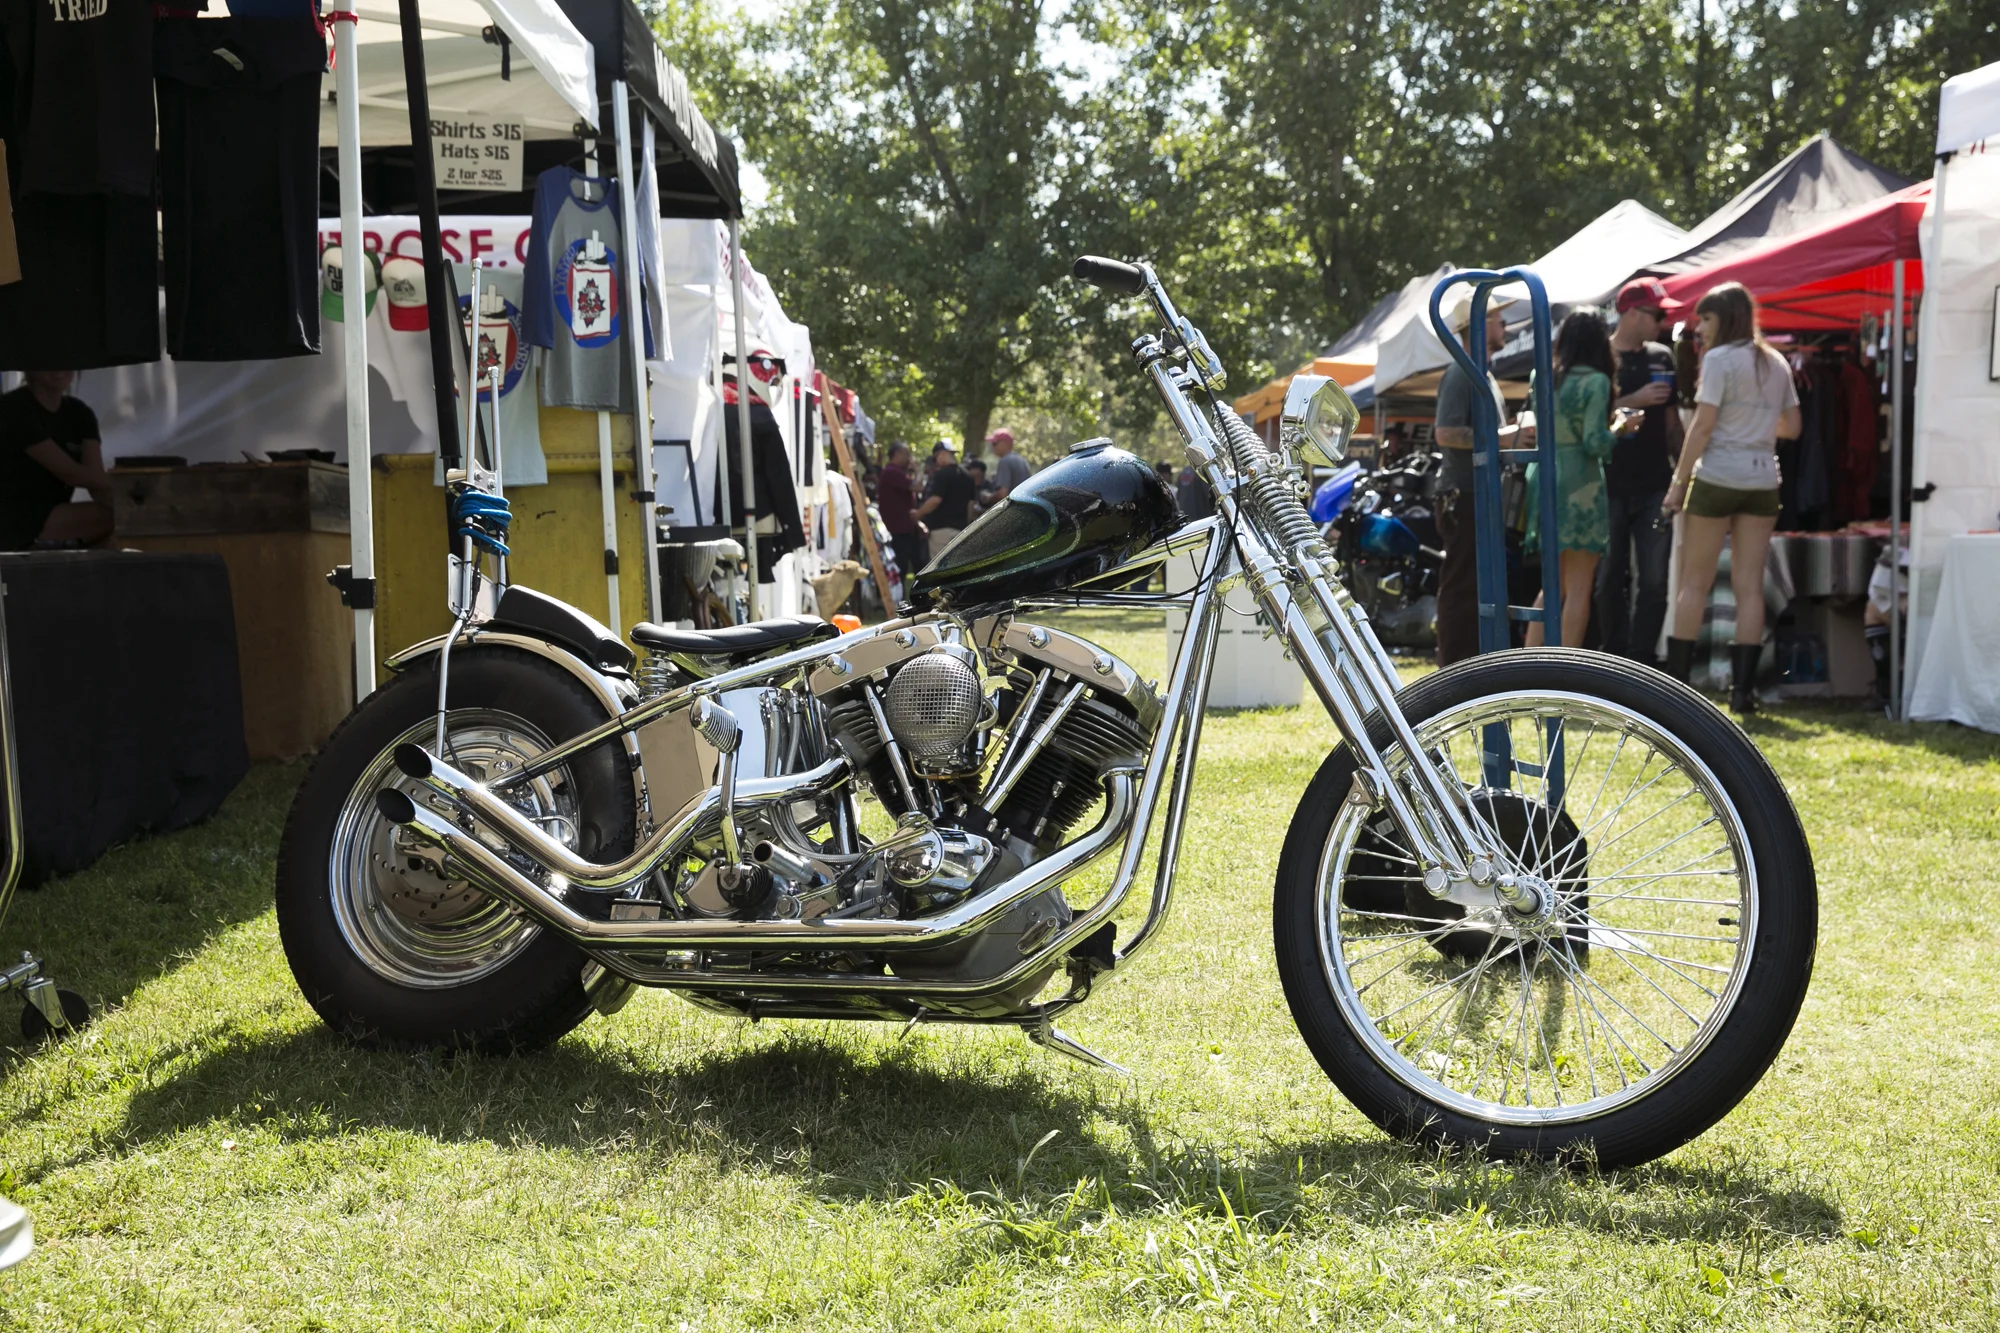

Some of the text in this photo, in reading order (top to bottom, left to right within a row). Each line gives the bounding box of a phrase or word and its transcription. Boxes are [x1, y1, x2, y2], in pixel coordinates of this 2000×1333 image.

[49, 0, 108, 21] TRIED
[430, 120, 522, 141] Shirts $15
[440, 143, 510, 160] Hats $15
[447, 167, 503, 180] 2 for $25
[327, 264, 343, 279] FU
